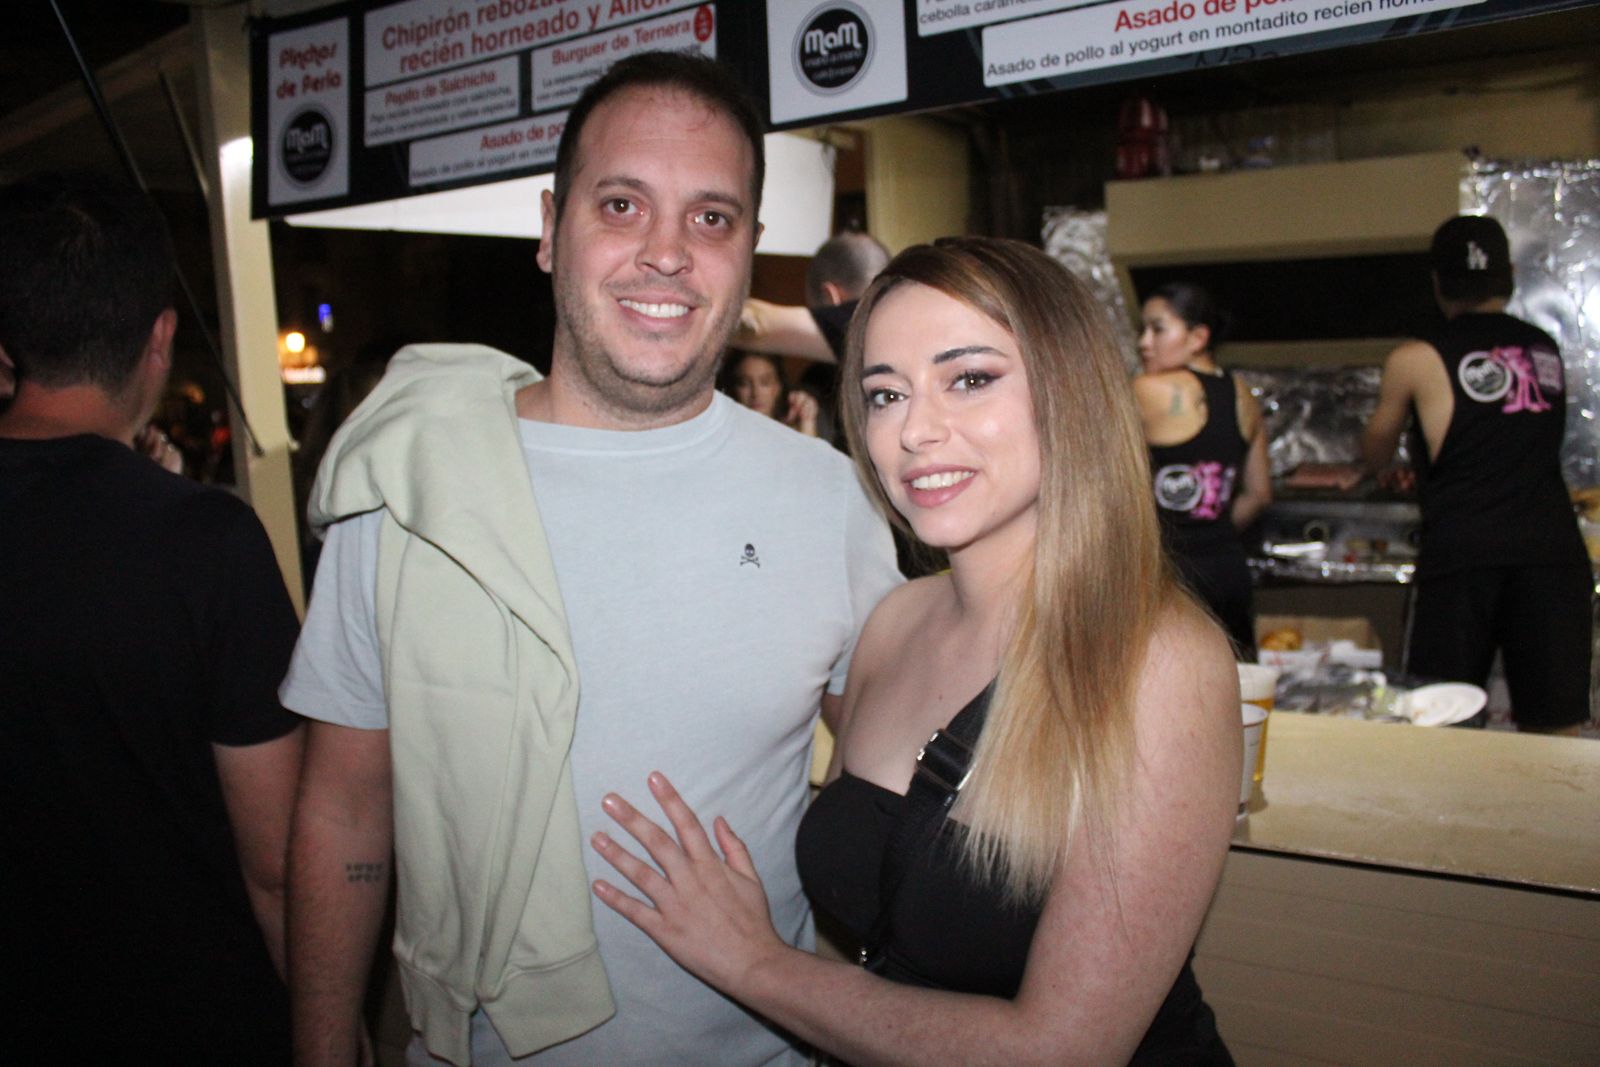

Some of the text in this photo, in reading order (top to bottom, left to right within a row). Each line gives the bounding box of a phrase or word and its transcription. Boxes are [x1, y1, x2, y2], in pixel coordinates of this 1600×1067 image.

[382, 0, 567, 50] Chipirón reboza
[919, 4, 970, 24] cebolla
[1114, 1, 1196, 33] Asado
[1203, 0, 1236, 15] de
[400, 37, 465, 73] recién
[472, 7, 580, 54] horneado
[588, 3, 601, 32] y
[552, 40, 607, 66] Burguer
[612, 33, 630, 51] de
[634, 20, 691, 46] Ternera
[987, 56, 1036, 77] Asado
[1040, 51, 1060, 69] de
[1065, 44, 1105, 66] pollo
[1110, 40, 1124, 56] al
[1129, 30, 1183, 56] yogurt
[1189, 27, 1210, 43] en
[1215, 11, 1308, 39] montadito
[1314, 0, 1372, 21] recien
[480, 129, 522, 151] Asado
[526, 122, 544, 141] de
